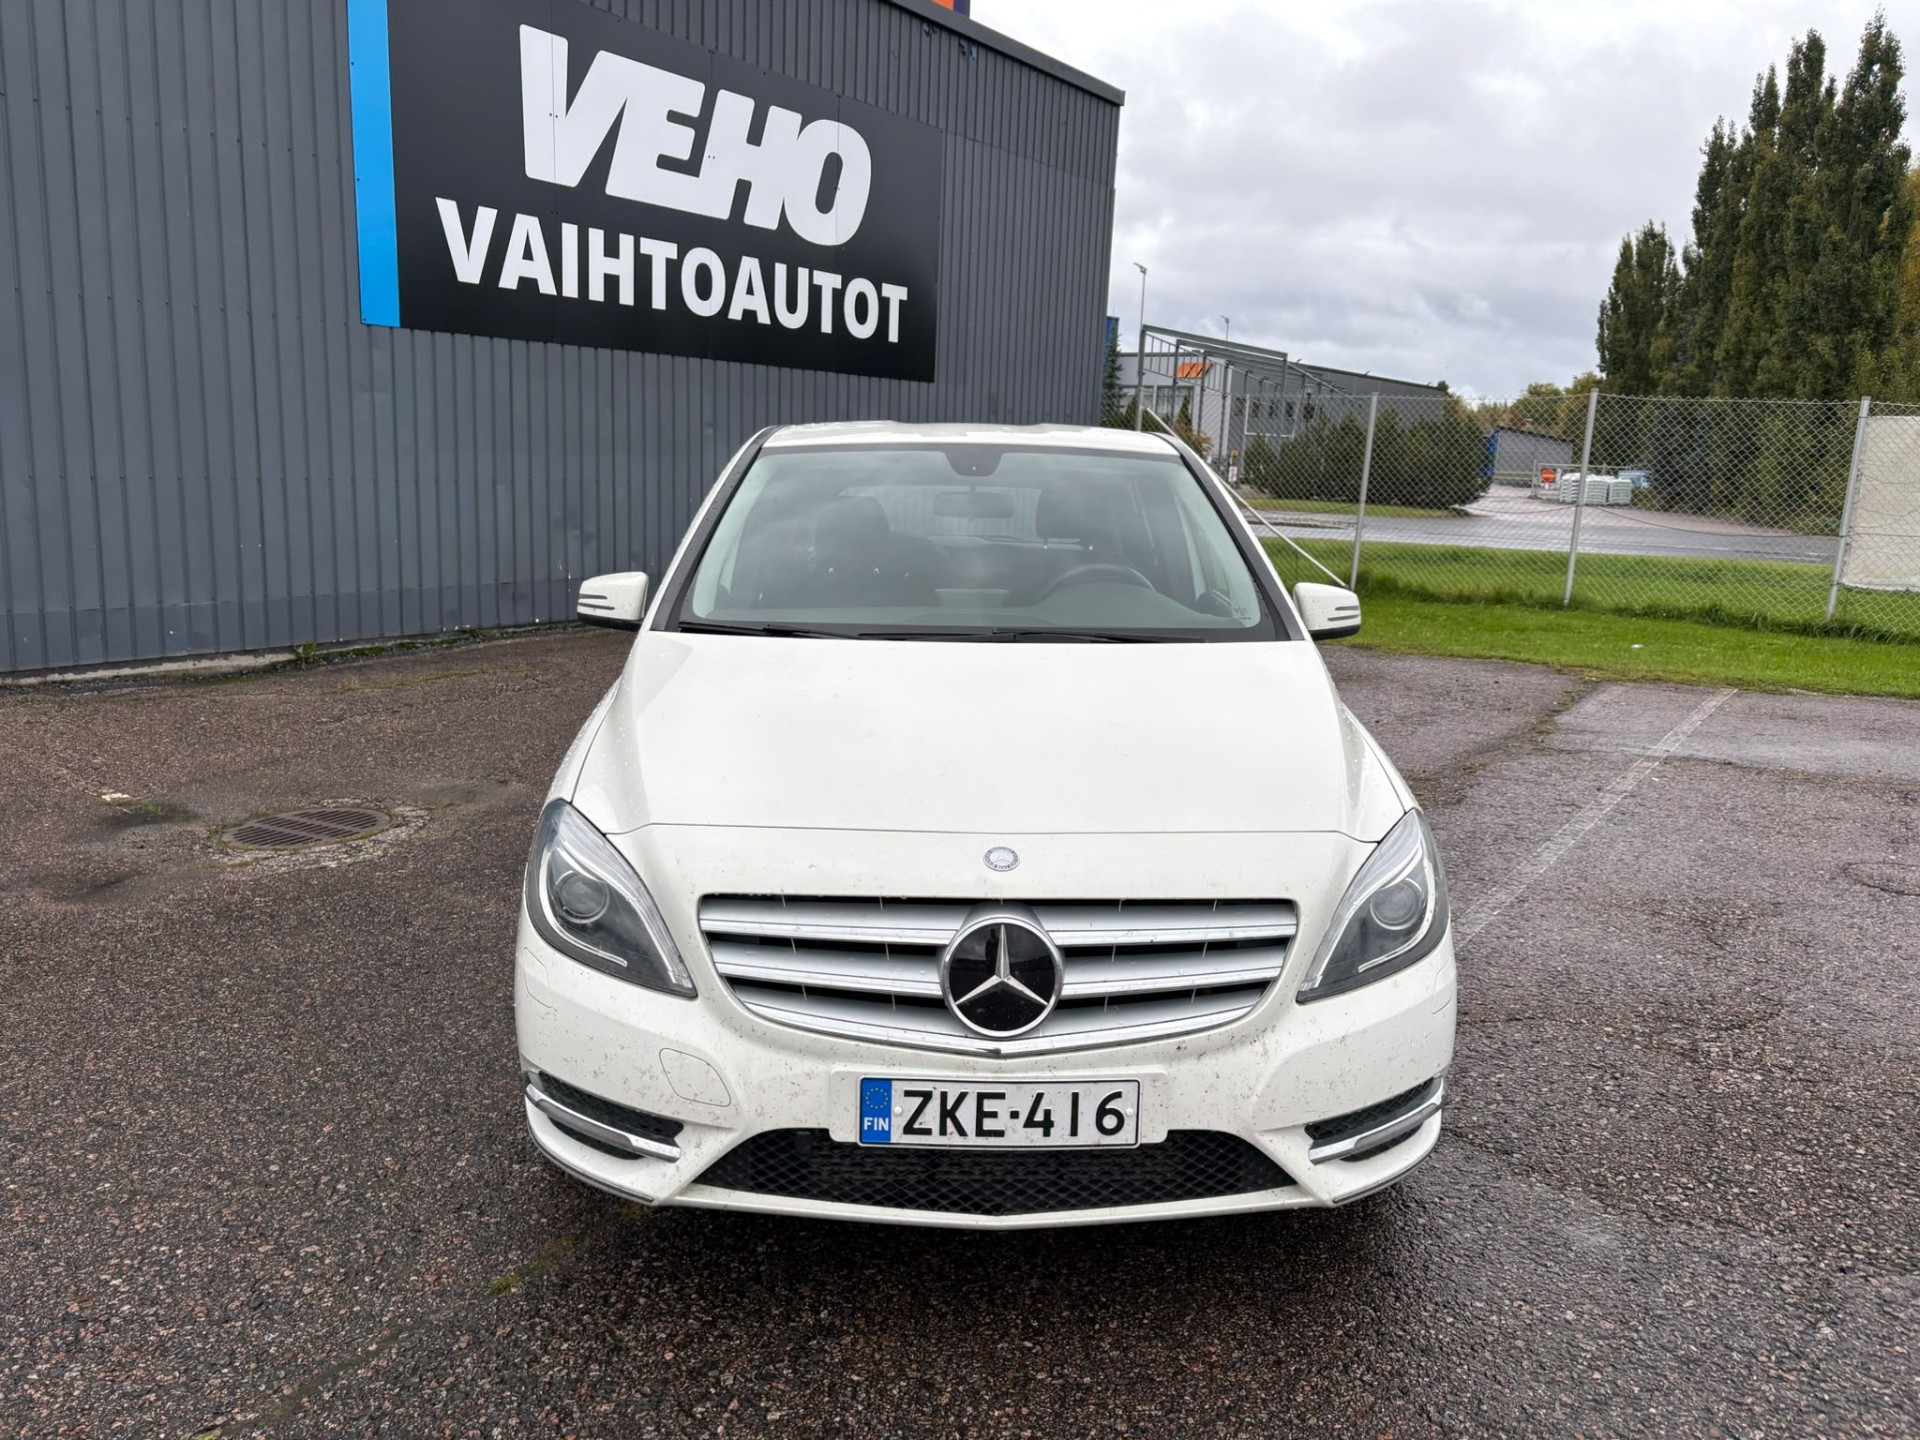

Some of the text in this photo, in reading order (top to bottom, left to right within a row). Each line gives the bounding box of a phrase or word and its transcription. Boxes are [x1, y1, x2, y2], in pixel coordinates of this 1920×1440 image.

[519, 23, 872, 247] VEHO
[435, 196, 908, 343] VAIHTOAUTOT
[863, 1117, 889, 1132] FIN
